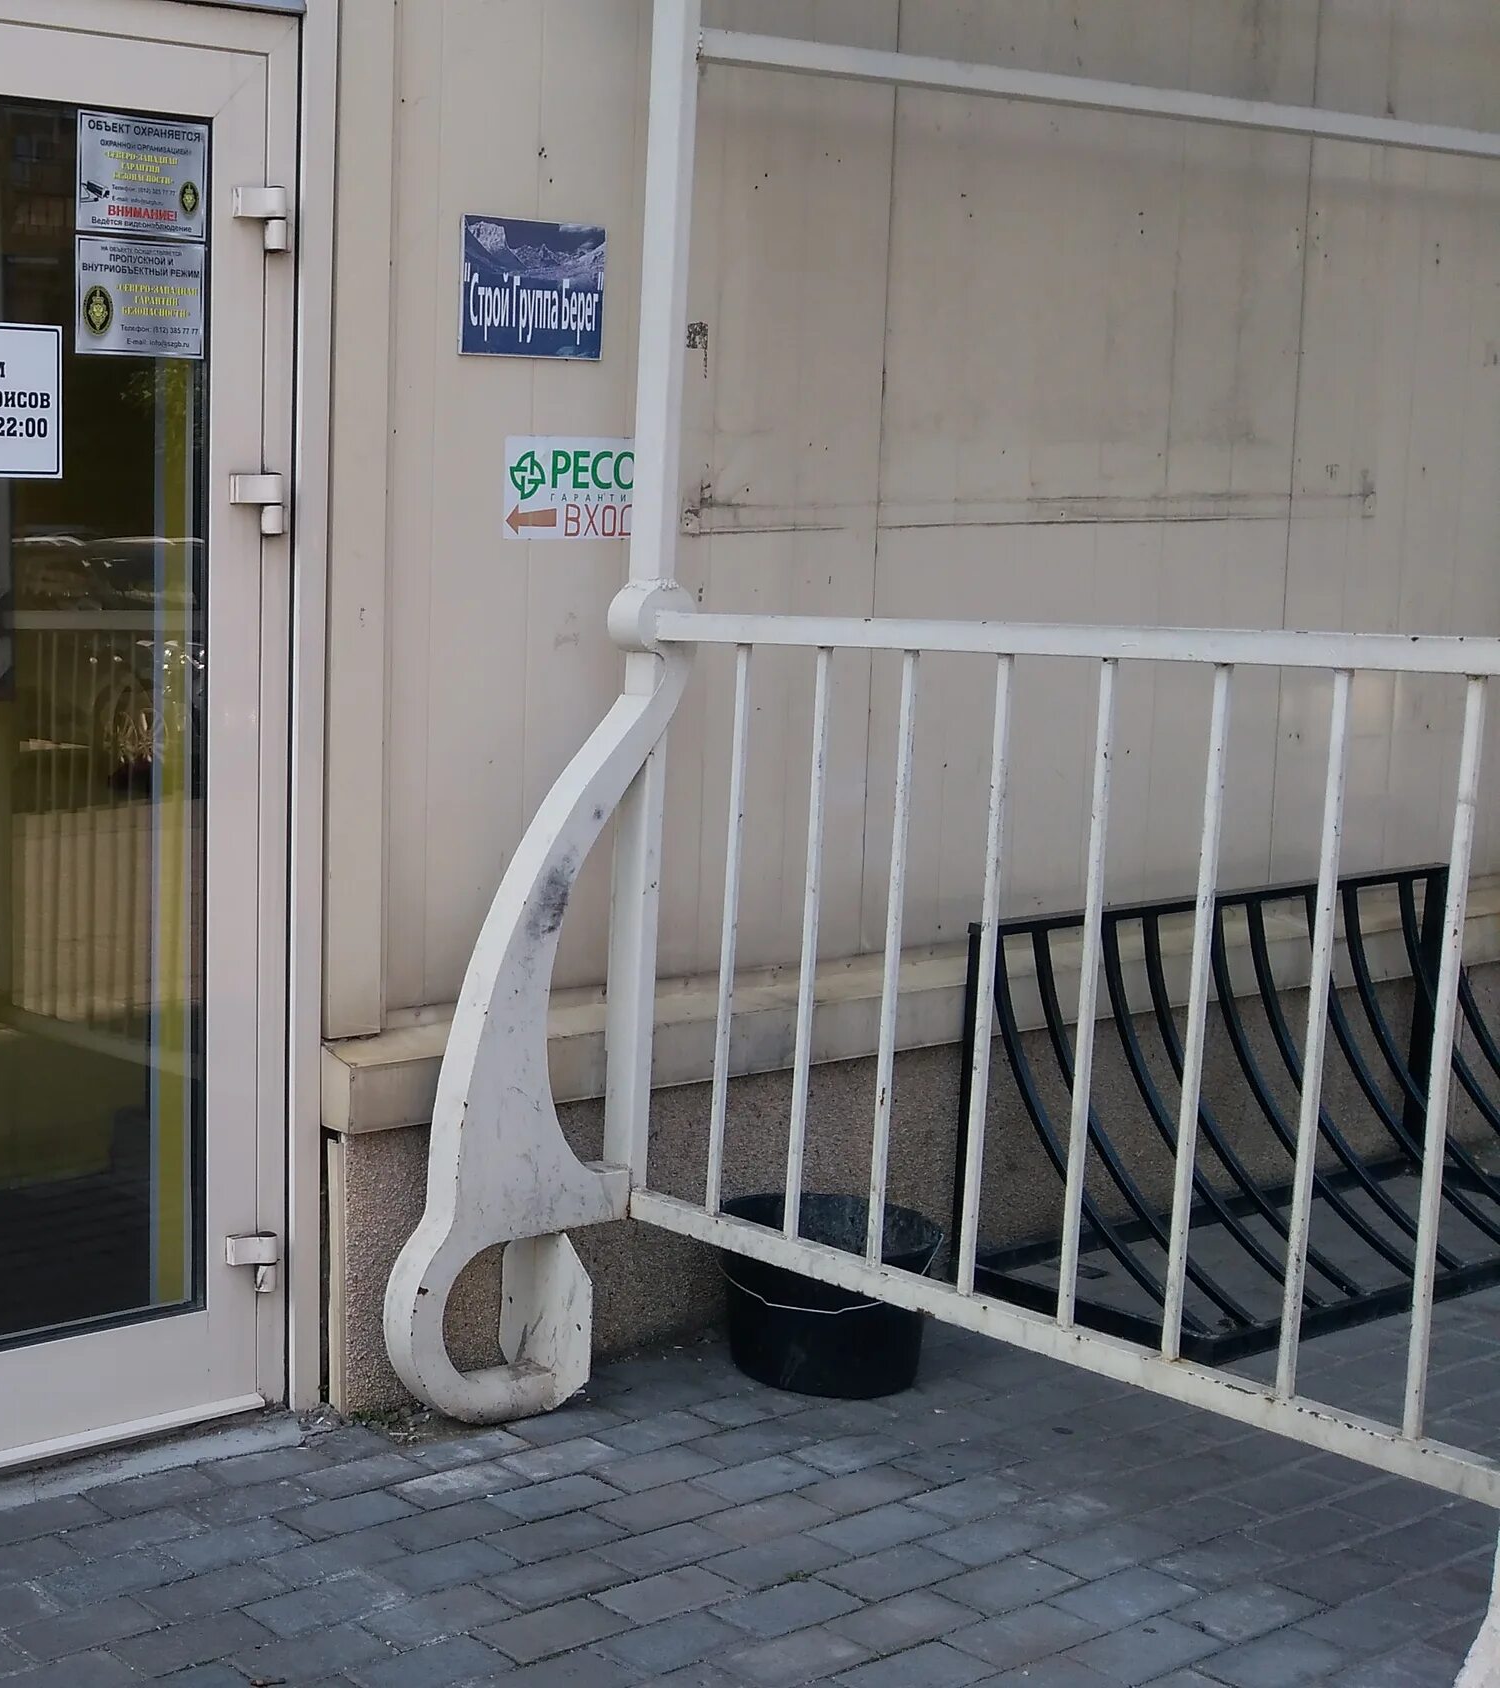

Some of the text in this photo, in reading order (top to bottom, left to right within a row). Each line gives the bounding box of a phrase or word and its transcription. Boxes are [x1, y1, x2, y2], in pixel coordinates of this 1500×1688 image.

[88, 119, 201, 142] ОБЪЕКТ ОХРАНЯЕТСЯ
[108, 204, 178, 222] ВНИМАНИЕ!
[124, 219, 192, 233] видеонаблюдение
[109, 253, 167, 266] ПРОПУСКНОЙ
[82, 262, 200, 279] ВНУТРИОБЪЕКТНЫЙ РЕЖИМ
[512, 275, 559, 344] Группа
[551, 449, 635, 490] РЕСО
[550, 493, 627, 503] ГАРАНТИ
